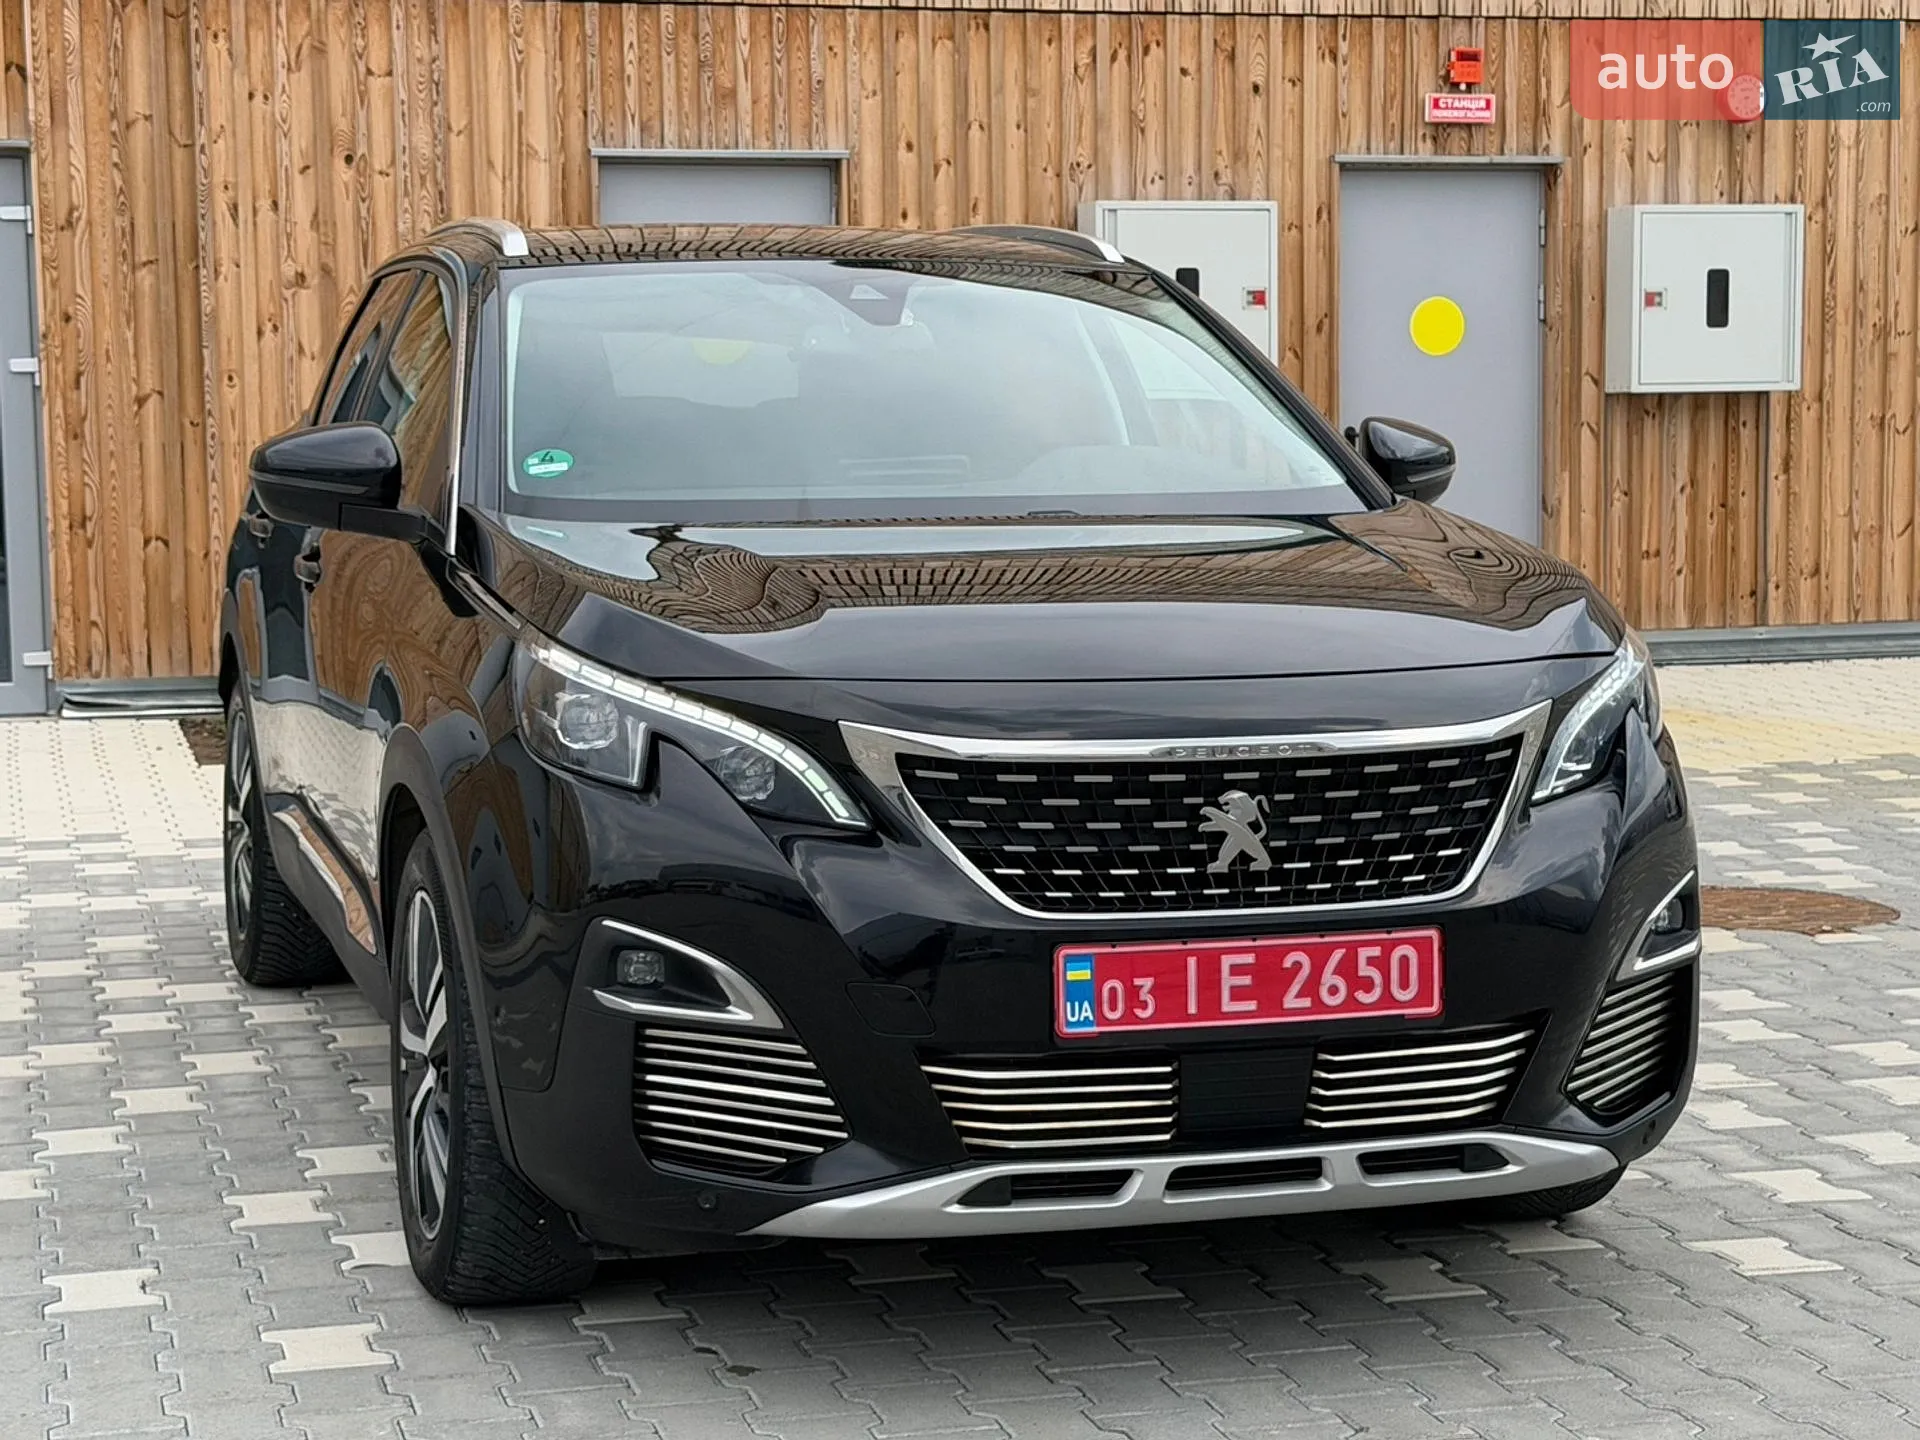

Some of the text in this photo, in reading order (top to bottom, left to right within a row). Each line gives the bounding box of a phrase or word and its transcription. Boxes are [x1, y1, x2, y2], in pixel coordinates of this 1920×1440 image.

[1438, 98, 1487, 110] СТАНЦІЯ
[1101, 977, 1155, 1021] 03
[1282, 944, 1420, 1010] 2650
[1066, 1001, 1094, 1023] UA
